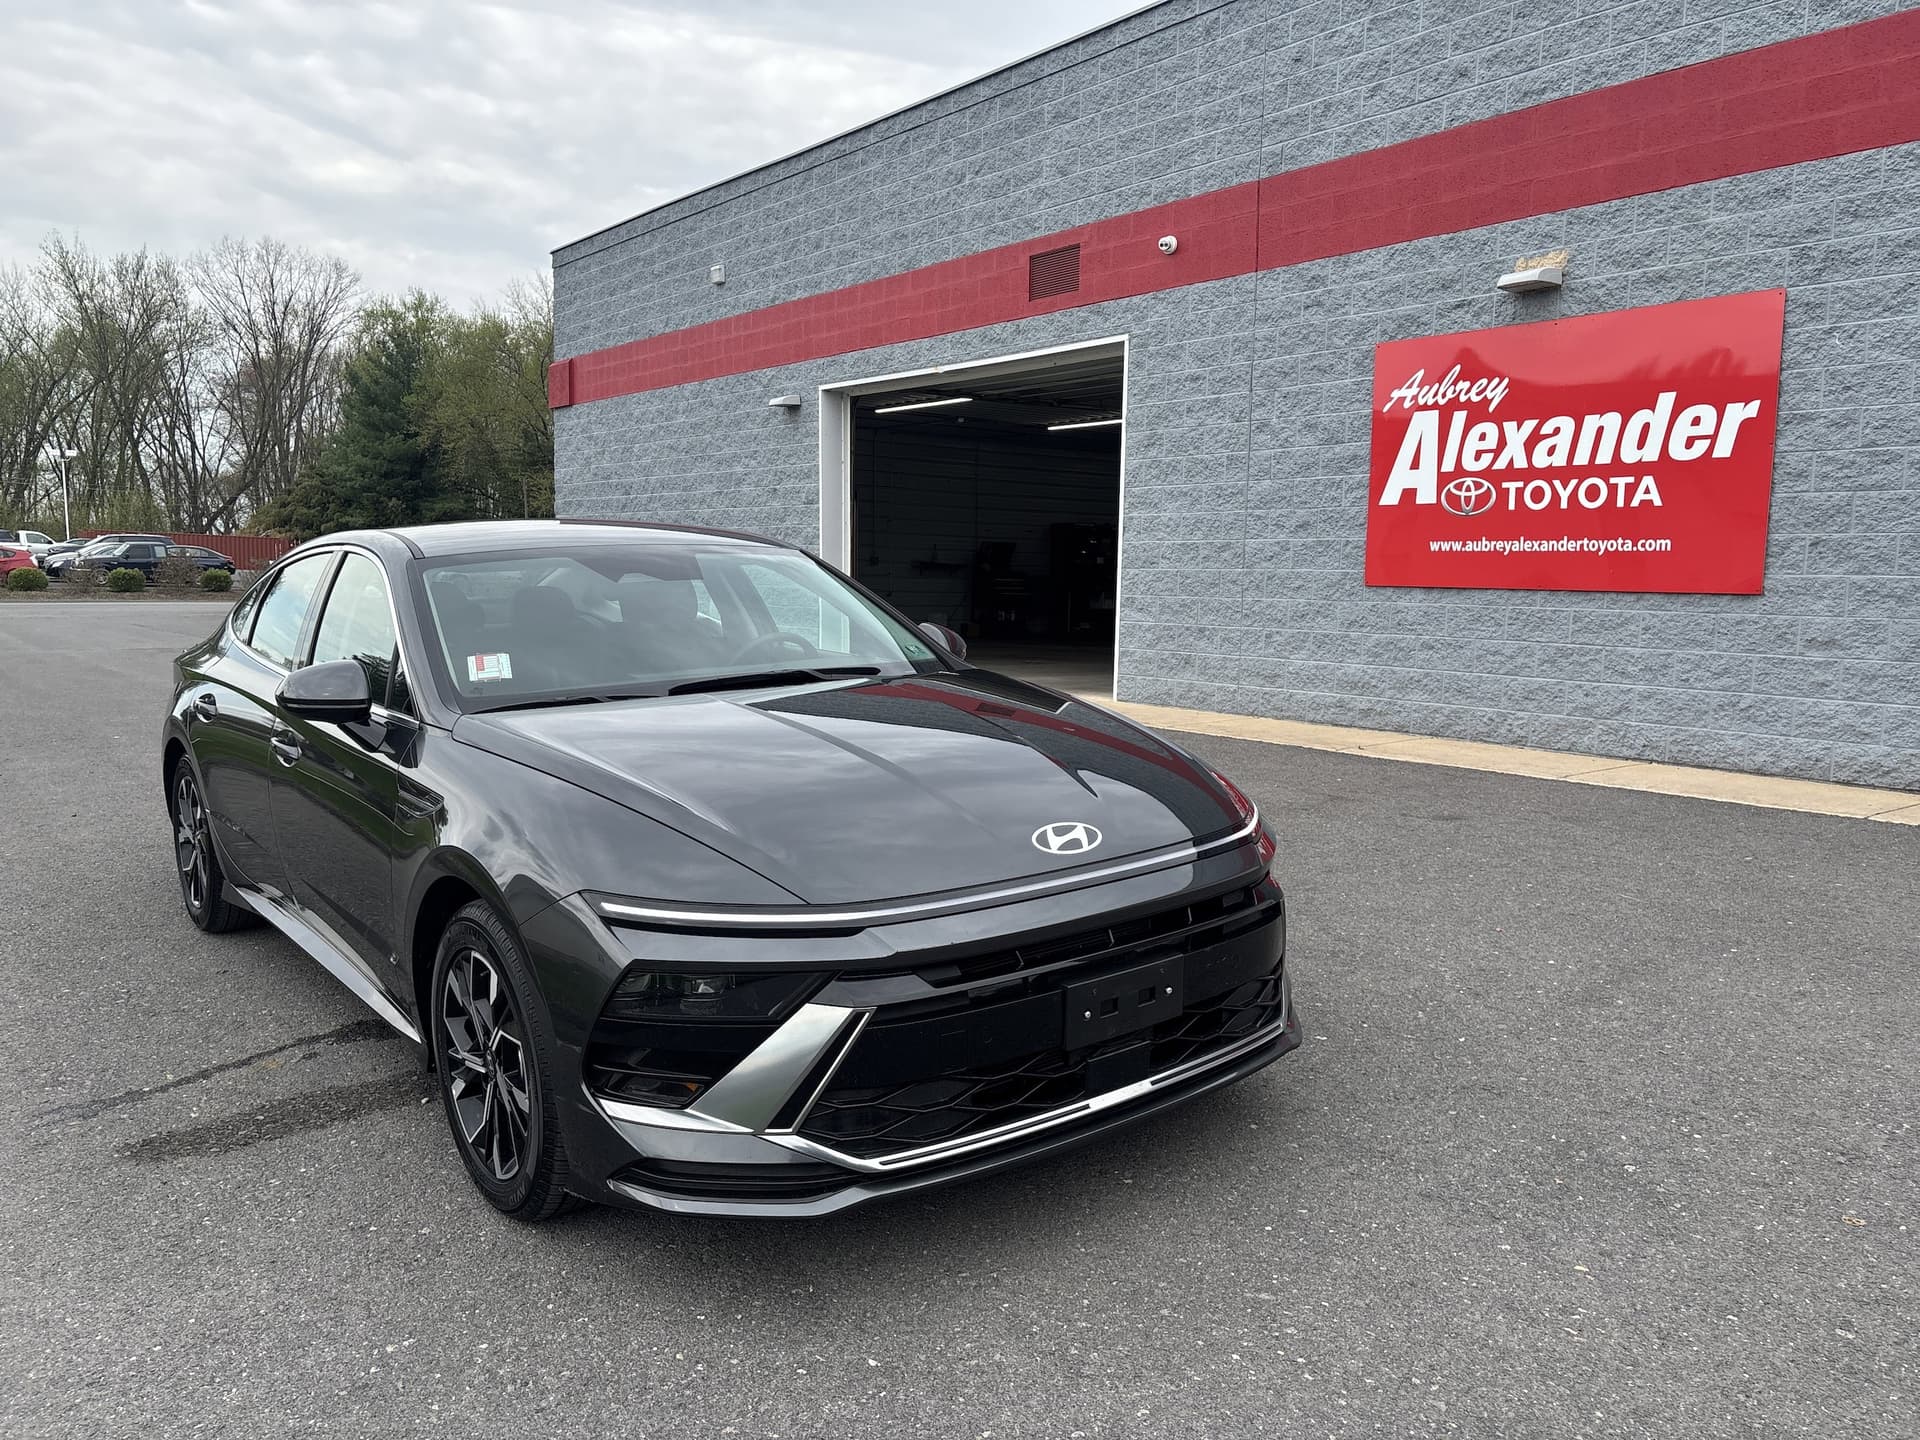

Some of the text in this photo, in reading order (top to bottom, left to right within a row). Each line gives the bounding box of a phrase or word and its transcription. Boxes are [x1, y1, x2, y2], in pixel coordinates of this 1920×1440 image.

[1383, 364, 1509, 413] Aubrey
[1378, 391, 1761, 506] Alexander
[1501, 476, 1663, 511] TOYOTA
[1429, 536, 1672, 556] www.aubreyalexandertoyota.com
